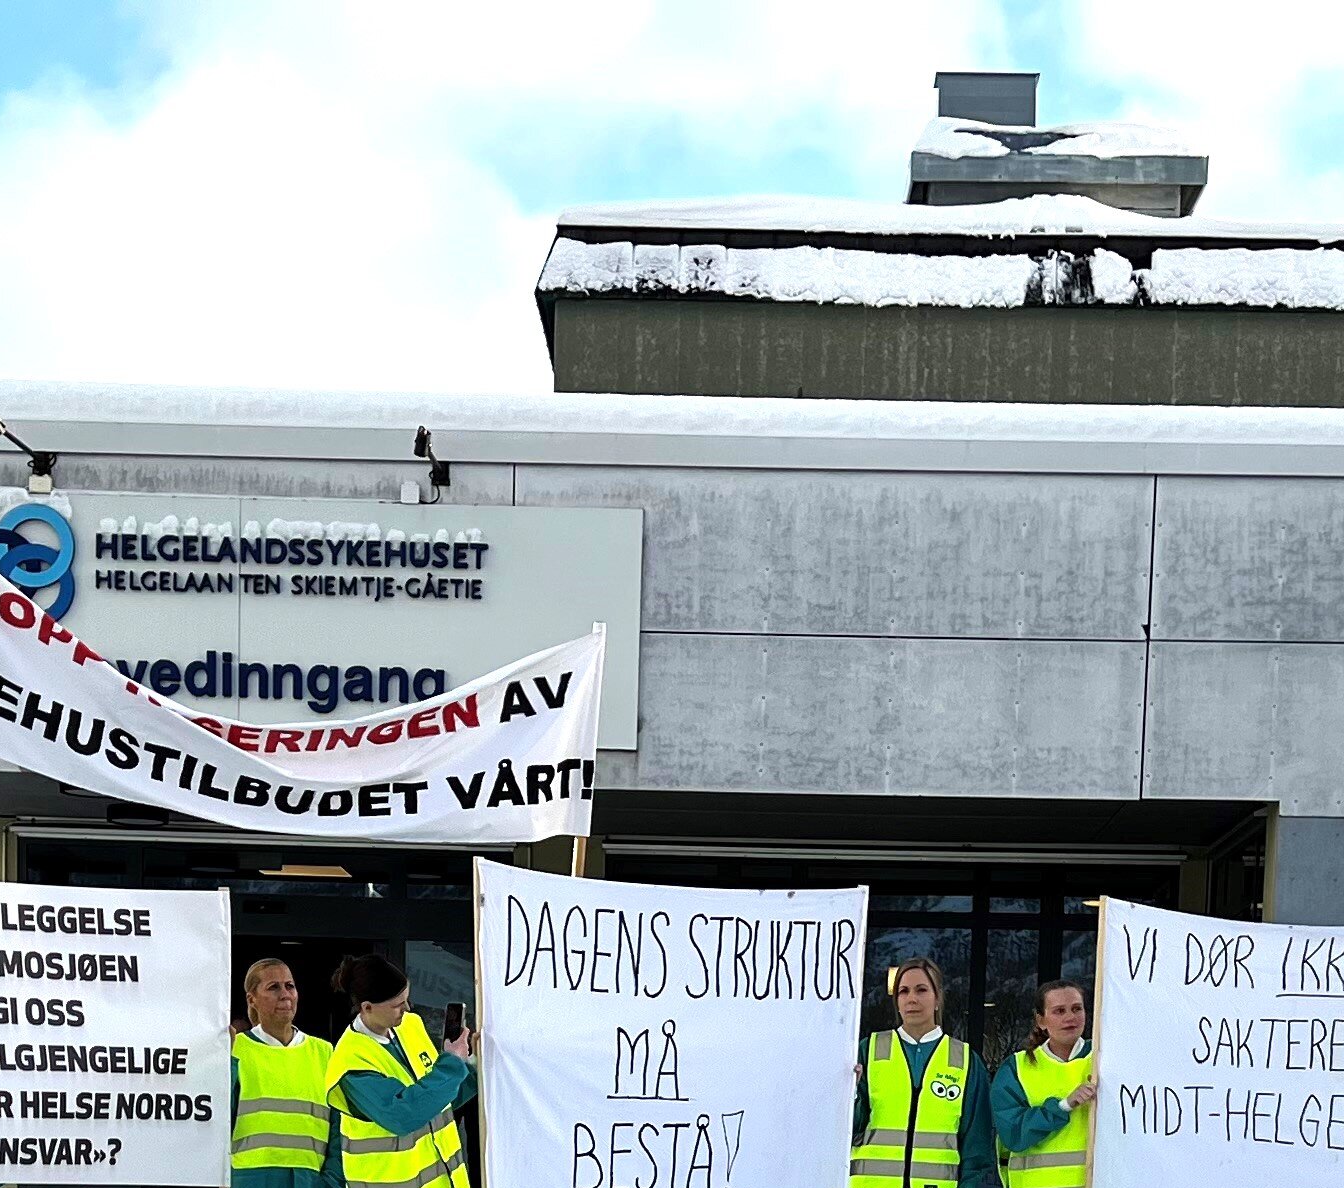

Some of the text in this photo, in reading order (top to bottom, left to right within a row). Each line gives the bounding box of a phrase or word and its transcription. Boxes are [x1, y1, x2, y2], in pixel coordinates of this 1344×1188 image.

[95, 533, 489, 569] HELGELANDSSYKEHUSET
[95, 570, 482, 602] HELGELAAN TEN SKIEMTJE-GÅETIE
[116, 650, 445, 714] vedinngang
[499, 671, 573, 723] AV
[446, 758, 595, 810] VÅRT!
[505, 895, 855, 1001] DAGENS STRUKTUR
[1123, 925, 1157, 982] VI
[1185, 933, 1254, 988] DØR
[26, 998, 84, 1027] OSS
[614, 1019, 681, 1099] MÅ
[21, 1091, 110, 1119] HELSE
[116, 1093, 212, 1121] NORDS
